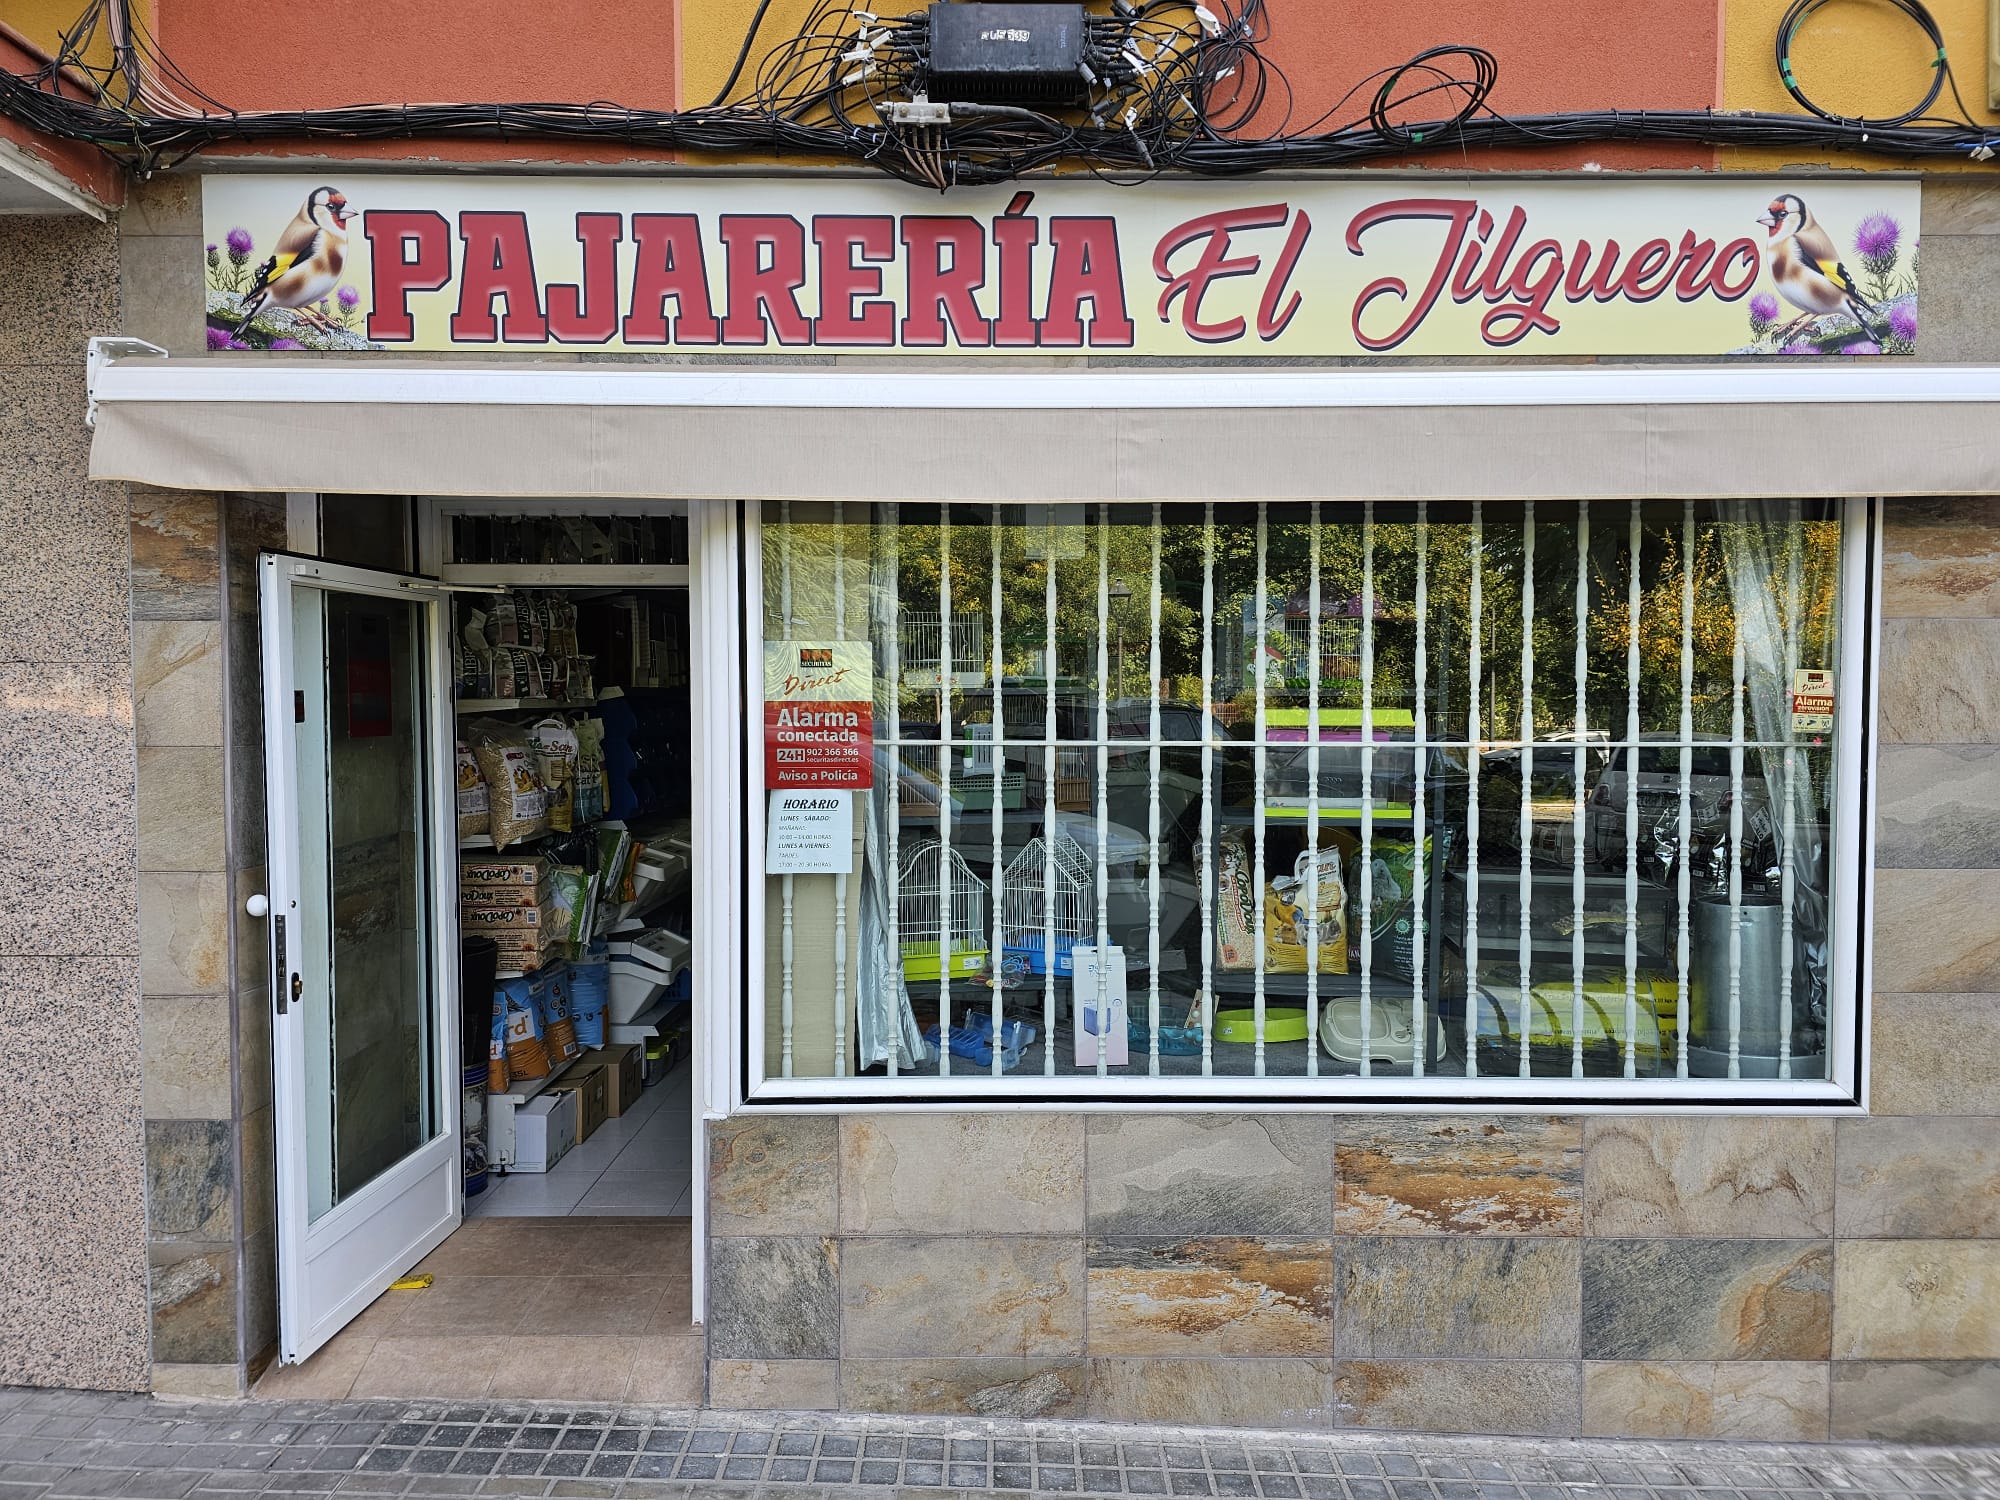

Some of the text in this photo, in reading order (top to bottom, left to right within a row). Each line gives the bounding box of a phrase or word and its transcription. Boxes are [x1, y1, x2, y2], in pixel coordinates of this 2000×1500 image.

[363, 189, 1761, 352] PAJARERÍA El Jilguero
[782, 668, 852, 695] Direct
[1795, 696, 1833, 706] Alarma
[777, 708, 859, 727] Alarma
[777, 728, 859, 742] conectada
[778, 750, 804, 761] 24H
[807, 748, 859, 756] 902 366 366
[778, 769, 858, 781] Aviso a Policía
[782, 799, 839, 810] HORARIO
